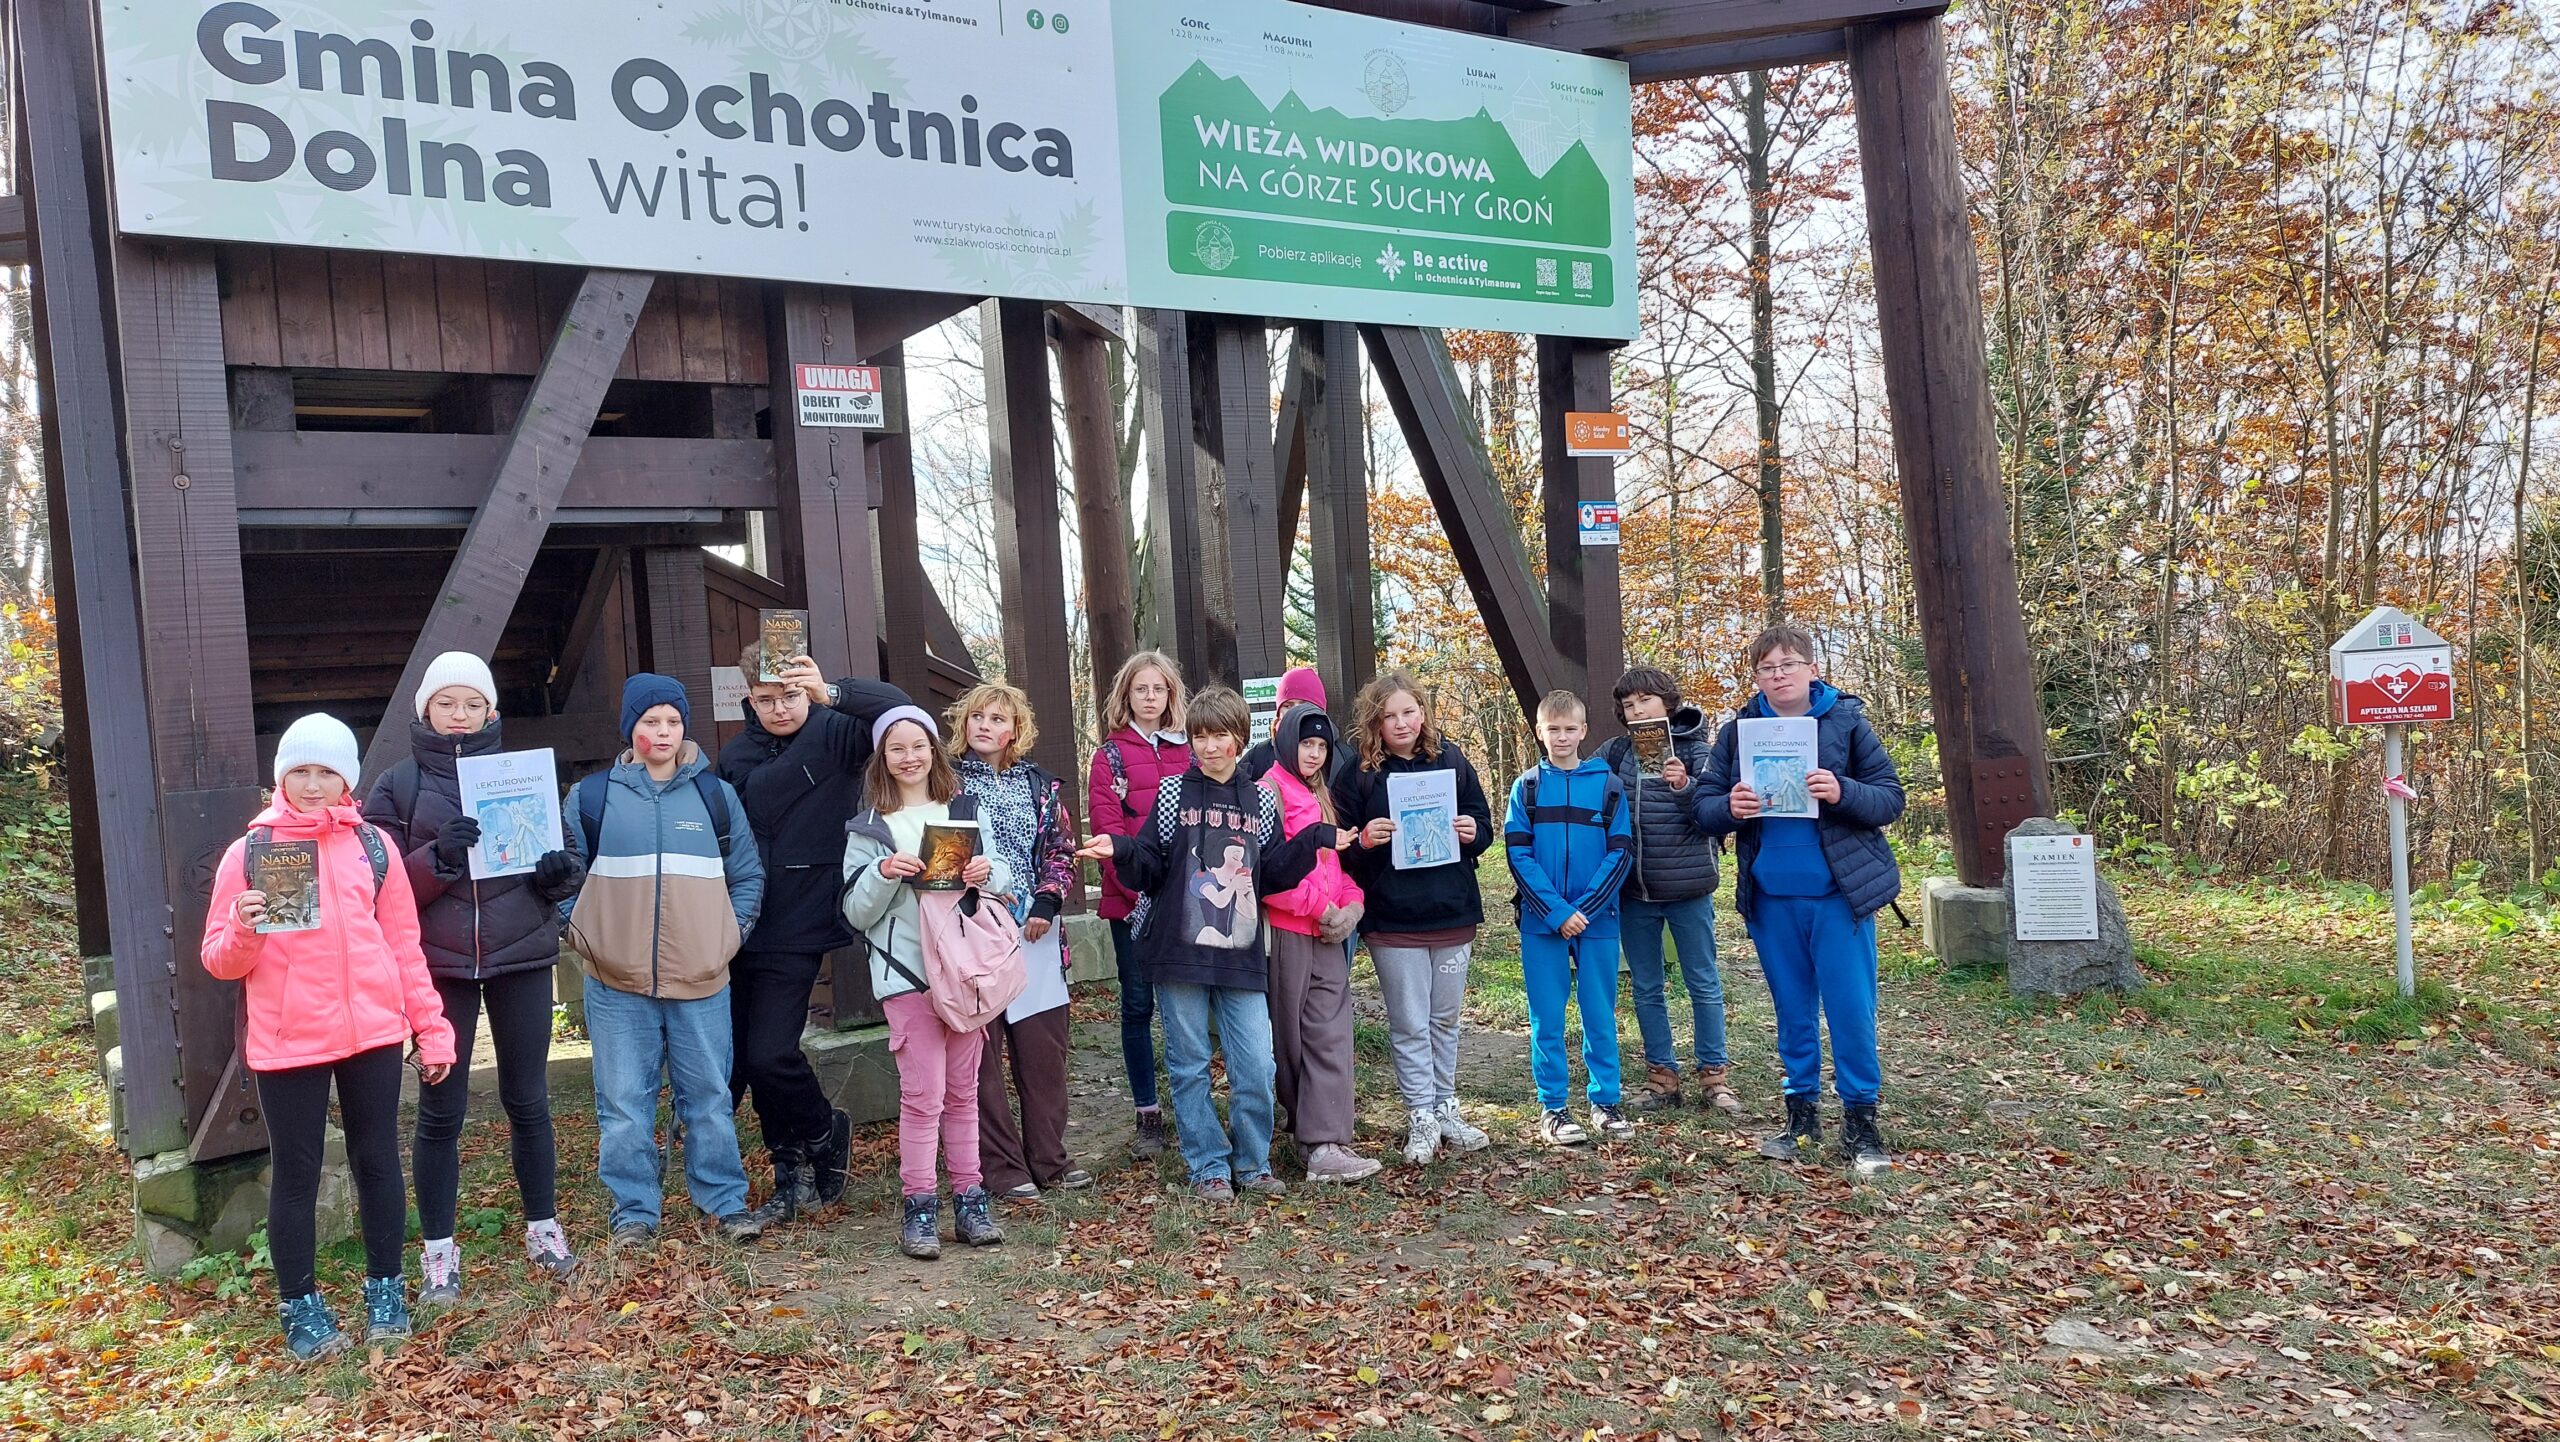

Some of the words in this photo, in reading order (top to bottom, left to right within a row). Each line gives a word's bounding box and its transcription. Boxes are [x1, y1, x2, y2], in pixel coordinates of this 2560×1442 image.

[1180, 17, 1211, 31] GORC
[1170, 28, 1193, 40] 1228
[1263, 31, 1313, 48] MAGURKI
[1466, 67, 1497, 80] LUBAŃ
[196, 1, 576, 121] Gmina
[611, 57, 1074, 179] Ochotnica
[1550, 81, 1577, 93] SUCHY
[1580, 86, 1604, 97] GROŃ
[1193, 114, 1308, 161] WIEŻA
[1316, 136, 1495, 184] WIDOKOWA
[205, 99, 551, 209] Dolna
[588, 148, 809, 233] wita!
[1199, 160, 1249, 193] NA
[1259, 164, 1358, 206] GÓRZE
[1370, 178, 1466, 217] SUCHY
[1474, 191, 1553, 226] GROŃ
[913, 217, 1057, 240] www.turystyka.ochotnica.pl
[914, 234, 1072, 257] www.szlakwoloski.ochotnica.pl
[1258, 244, 1307, 263] Pobierz
[1310, 249, 1362, 268] aplikację
[1413, 250, 1433, 268] Be
[1438, 253, 1489, 273] active
[1414, 271, 1423, 282] in
[1425, 272, 1521, 290] Ochotnica&Tylmanowa
[804, 367, 873, 390] UWAGA
[802, 395, 840, 408] OBIEKT
[803, 411, 880, 424] MONITOROWANY
[2360, 707, 2397, 716] APTECZKA
[2410, 704, 2438, 713] SZLAKU
[475, 774, 544, 790] LEKTUROWNIK
[1400, 791, 1448, 803] LEKTUROWNIK
[2033, 852, 2075, 861] KAMIEŃ
